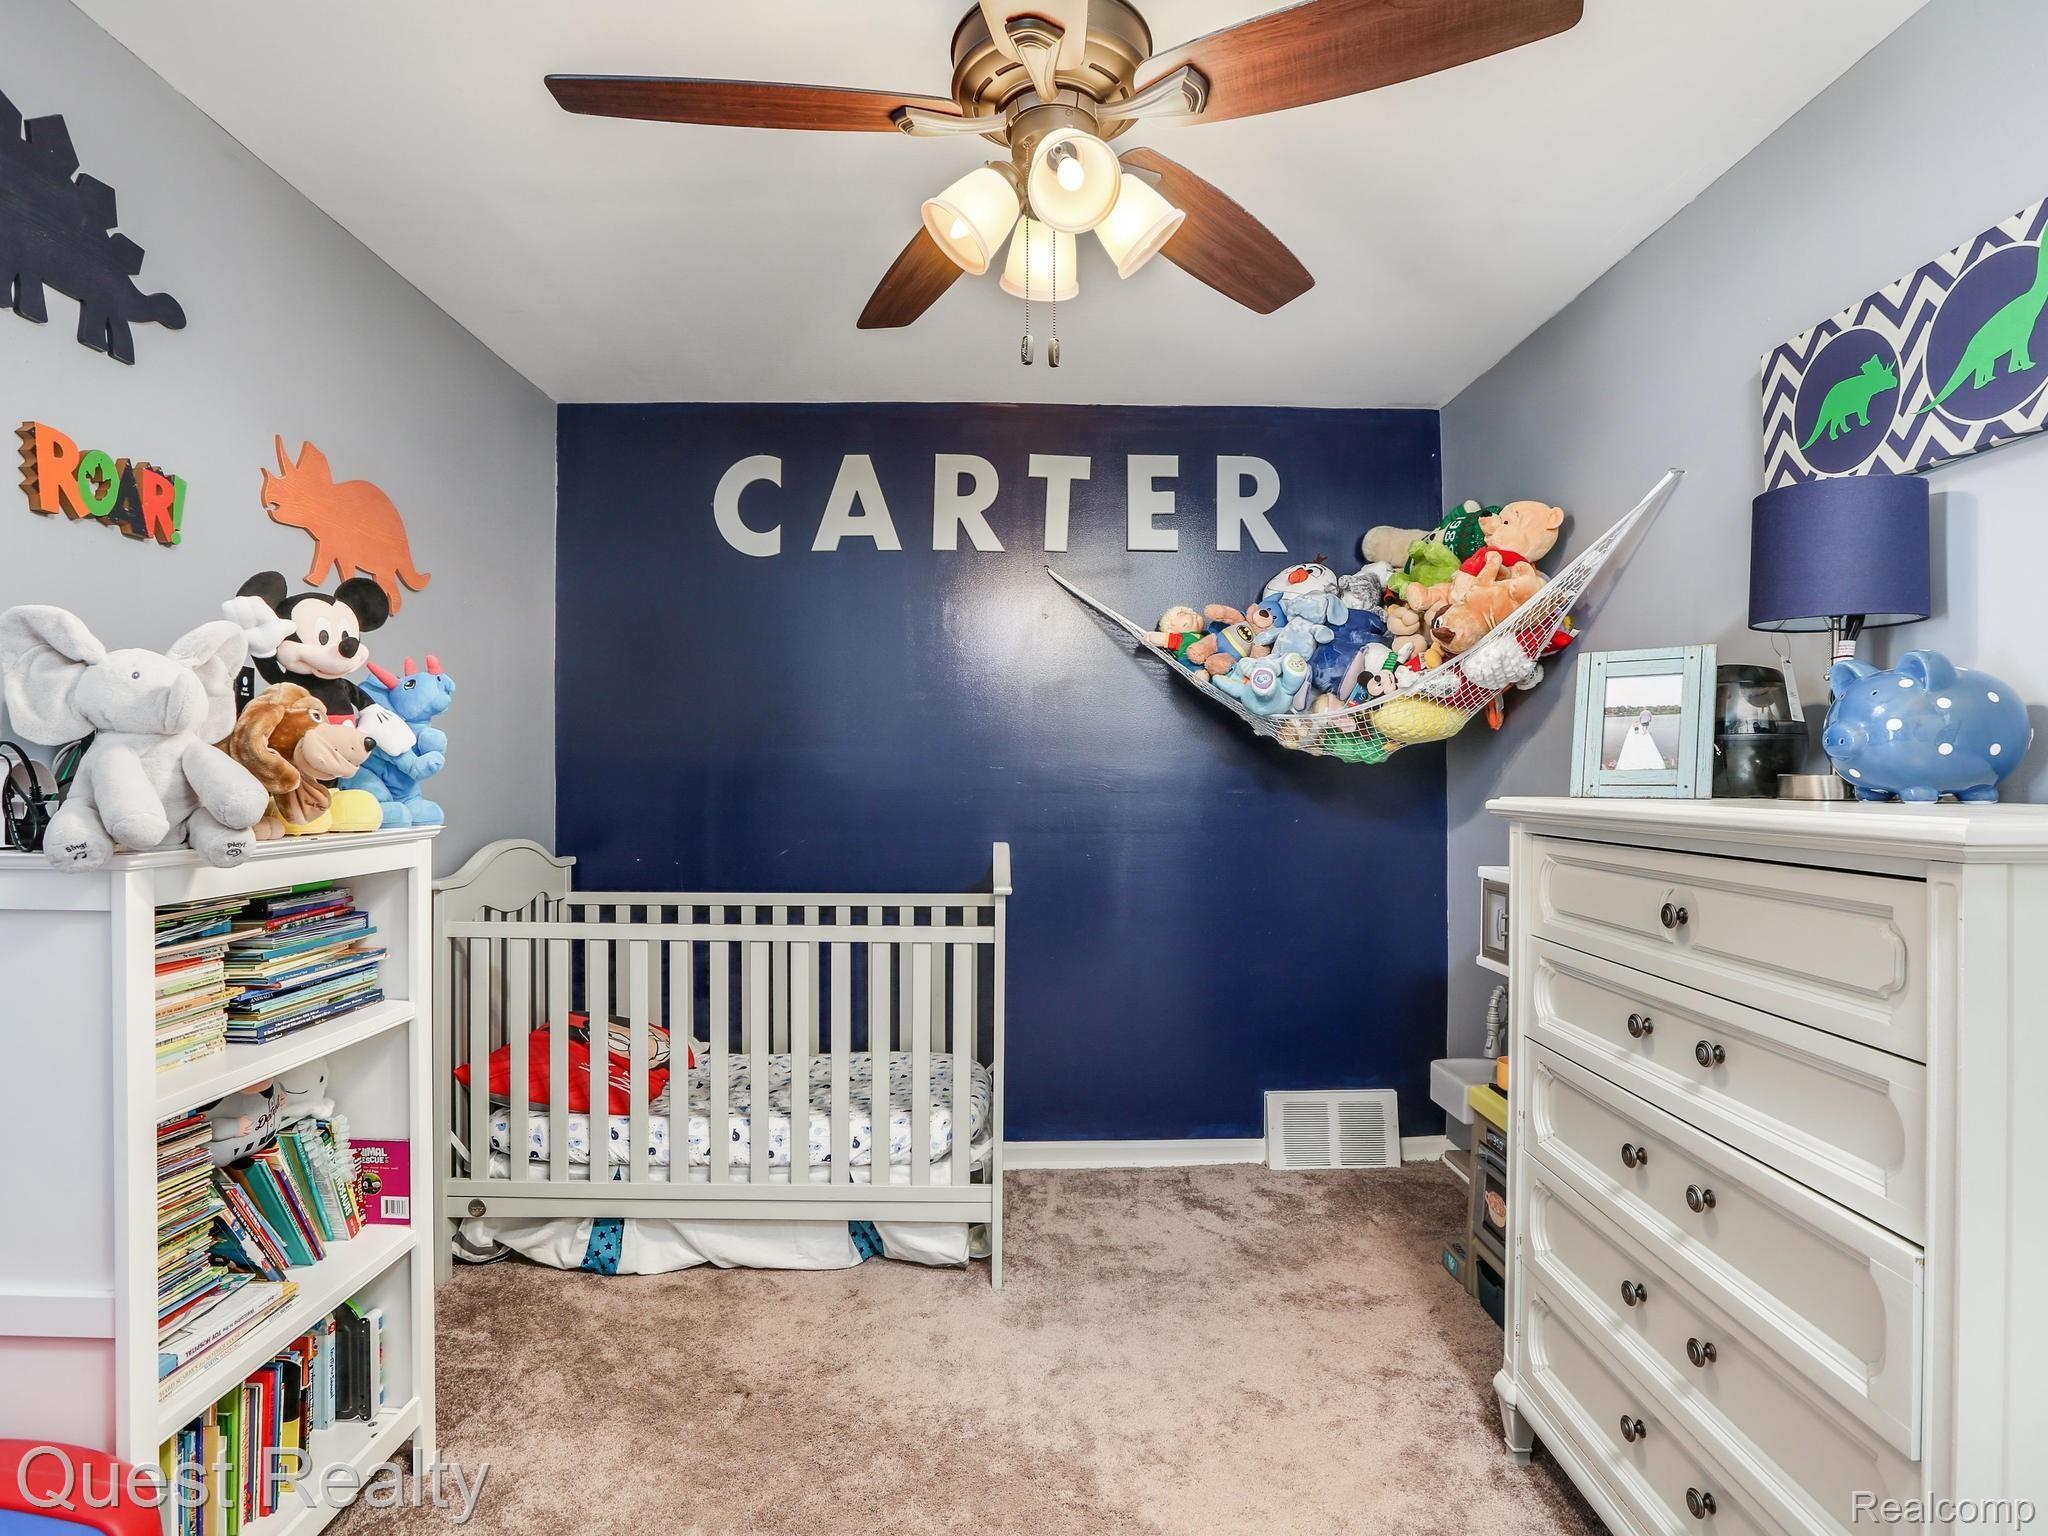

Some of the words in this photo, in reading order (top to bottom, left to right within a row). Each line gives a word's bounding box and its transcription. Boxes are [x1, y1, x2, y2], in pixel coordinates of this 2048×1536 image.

[18, 421, 187, 545] ROAR!
[713, 453, 1288, 557] CARTER
[185, 1336, 211, 1359] HOSPITAL
[211, 1330, 222, 1341] TOY
